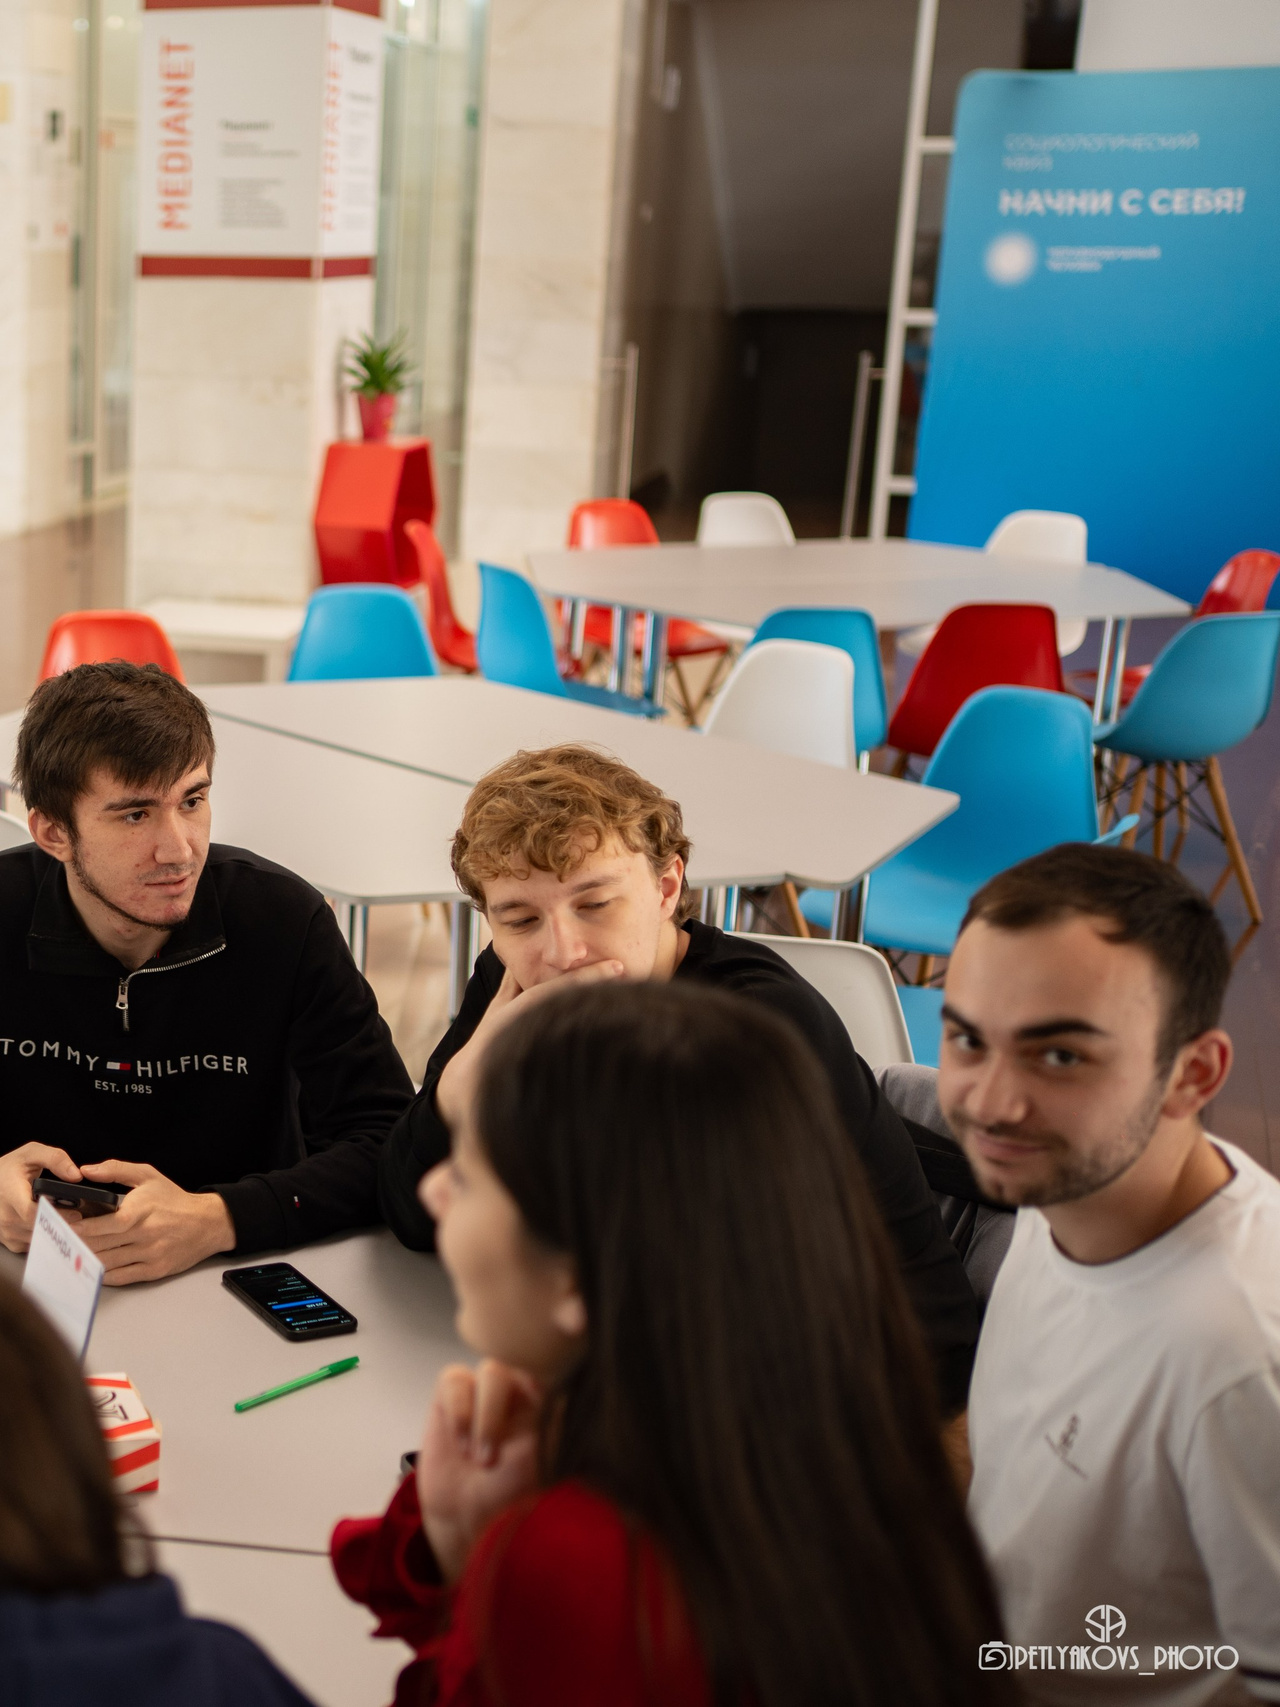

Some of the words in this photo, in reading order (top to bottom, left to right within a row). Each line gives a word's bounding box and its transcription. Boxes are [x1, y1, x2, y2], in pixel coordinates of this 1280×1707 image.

[157, 37, 195, 231] MEDIANET
[998, 188, 1114, 217] НАЧНИ
[1119, 188, 1144, 216] С
[1149, 187, 1246, 215] СЕБЯ!
[0, 1038, 99, 1071] TOMMY
[137, 1054, 249, 1078] HILFIGER
[95, 1080, 120, 1093] EST.
[125, 1083, 152, 1094] 1985
[39, 1213, 71, 1262] КОМАНДА
